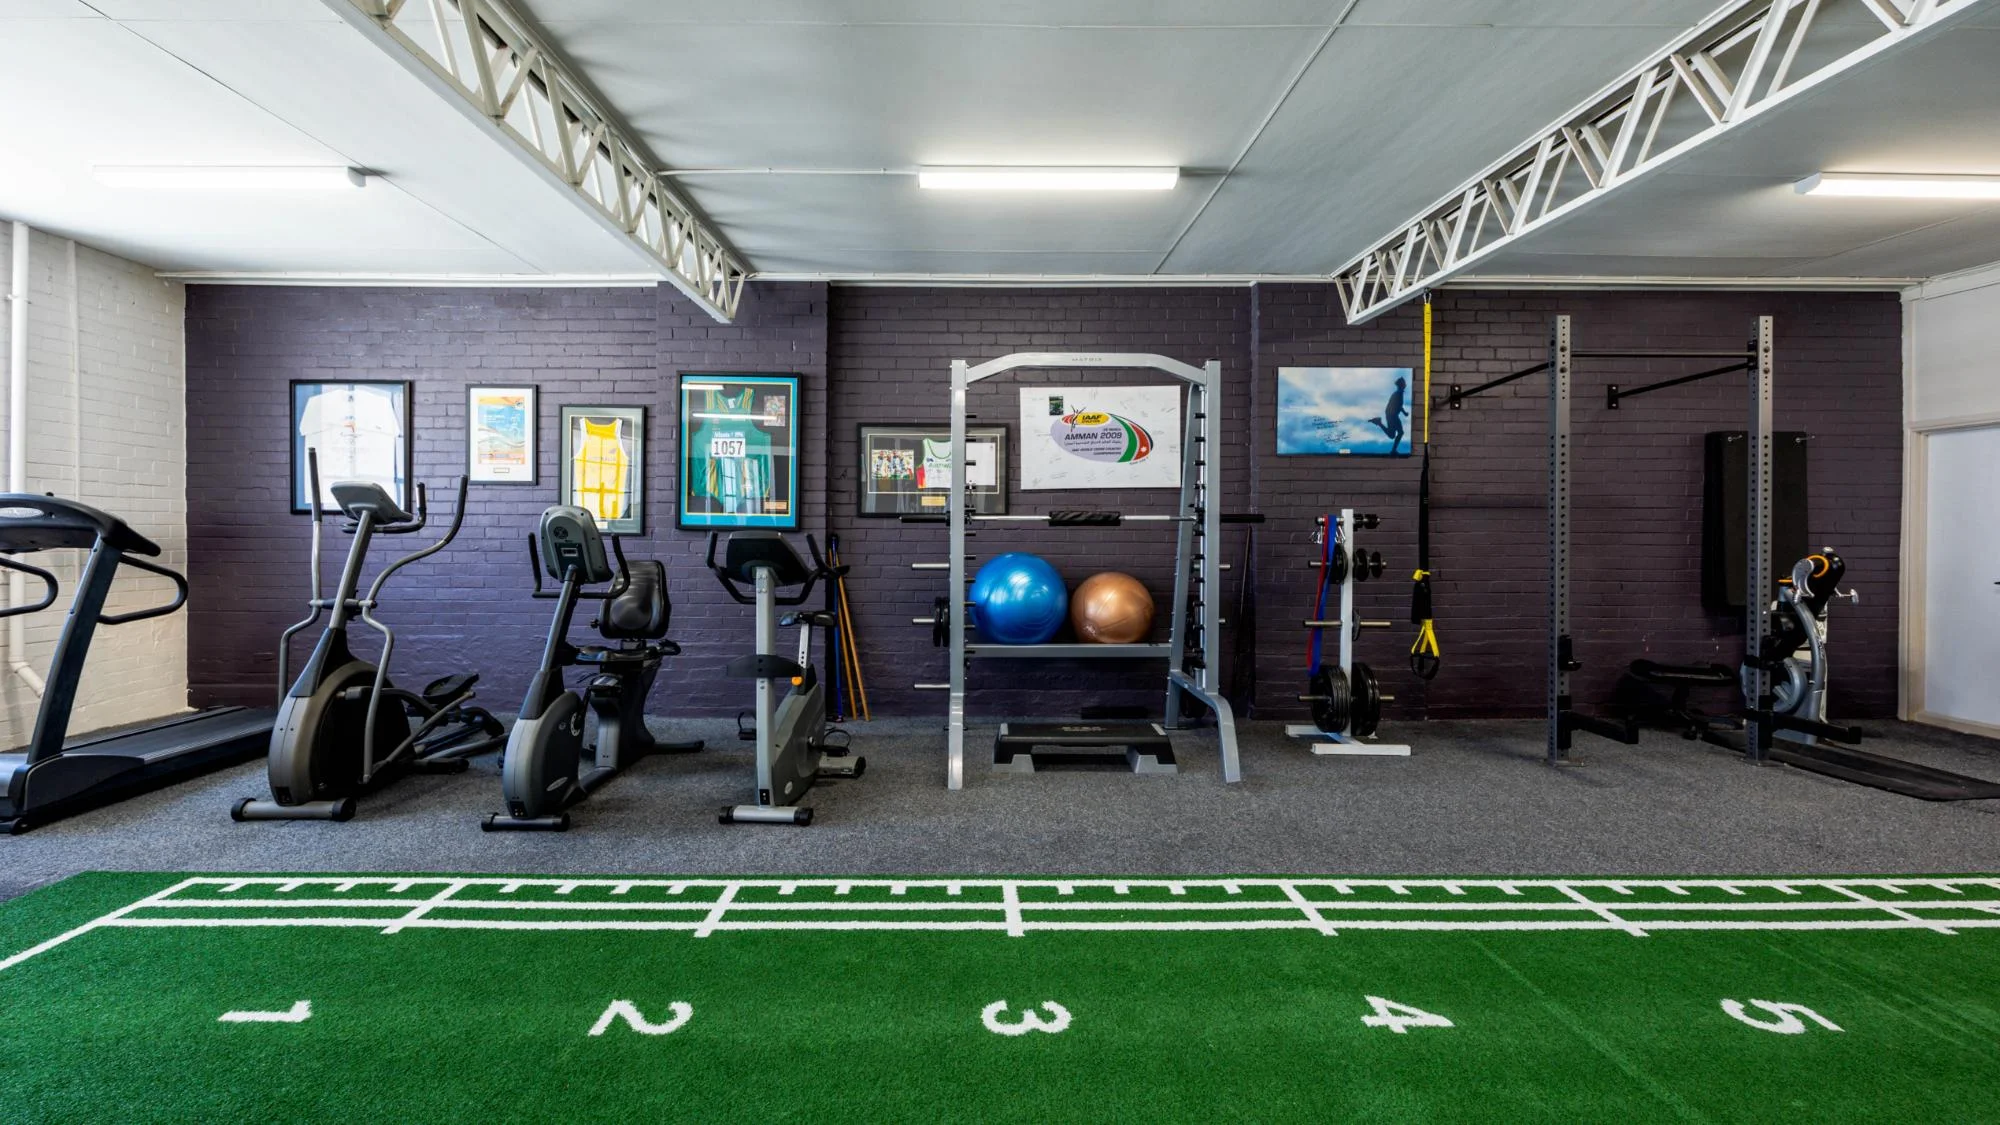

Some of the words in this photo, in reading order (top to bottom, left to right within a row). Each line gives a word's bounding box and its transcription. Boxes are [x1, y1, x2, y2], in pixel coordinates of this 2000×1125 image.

[713, 440, 743, 456] 1057
[1064, 432, 1098, 441] AMMAN
[1100, 431, 1123, 440] 2009
[218, 1000, 311, 1023] 1
[588, 1000, 693, 1036] 2
[981, 1000, 1072, 1036] 3
[1361, 995, 1454, 1034] 4
[1721, 999, 1844, 1034] 5
